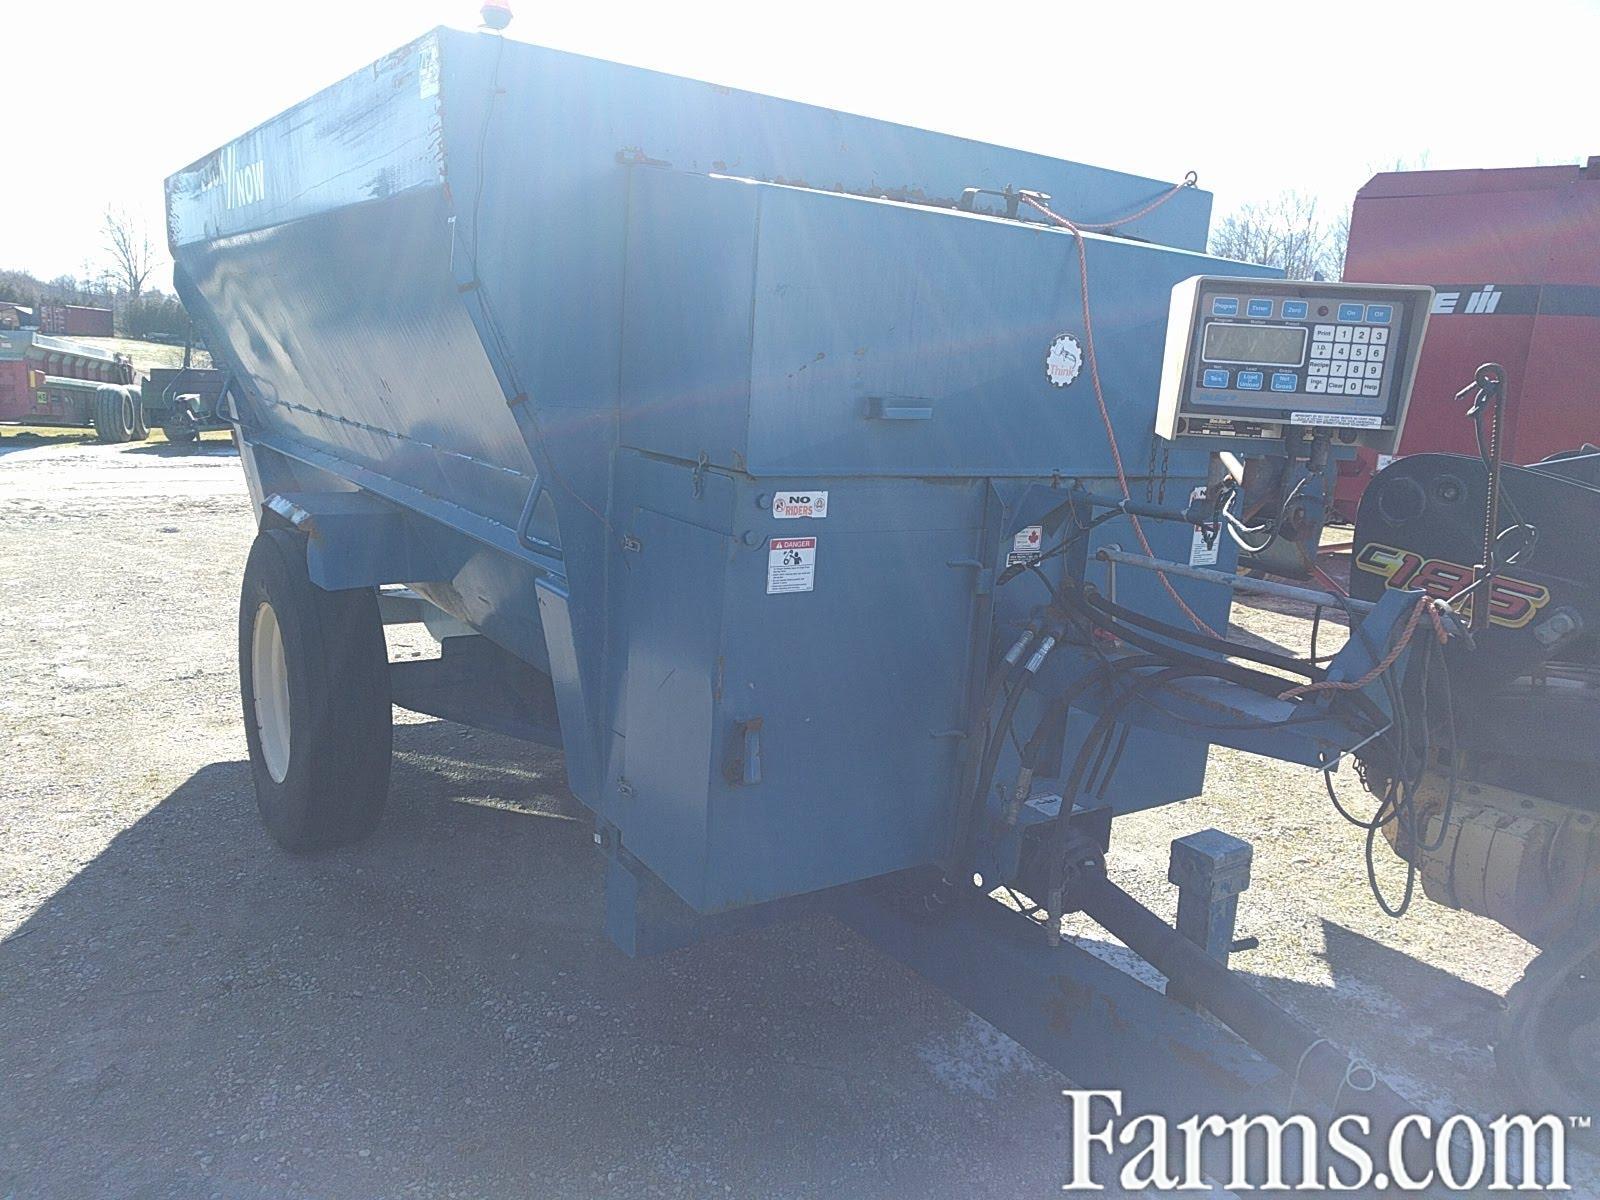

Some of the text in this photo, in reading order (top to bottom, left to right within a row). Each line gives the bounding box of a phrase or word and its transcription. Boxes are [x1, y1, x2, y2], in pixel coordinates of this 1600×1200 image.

[1374, 310, 1385, 318] Off
[1317, 329, 1331, 337] Print
[1342, 330, 1347, 338] 1
[1358, 331, 1365, 339] 2
[1375, 331, 1382, 340] 3
[1338, 347, 1344, 355] 4
[1355, 348, 1362, 356] 5
[1373, 349, 1380, 358] 6
[1309, 361, 1329, 369] Recipe
[1335, 364, 1342, 373] 7
[1353, 365, 1359, 374] 8
[1370, 366, 1377, 375] 9
[1350, 382, 1357, 391] 0
[1364, 383, 1378, 391] Help
[789, 496, 811, 504] NO
[785, 505, 813, 516] RIDERS
[783, 540, 811, 548] DANGER
